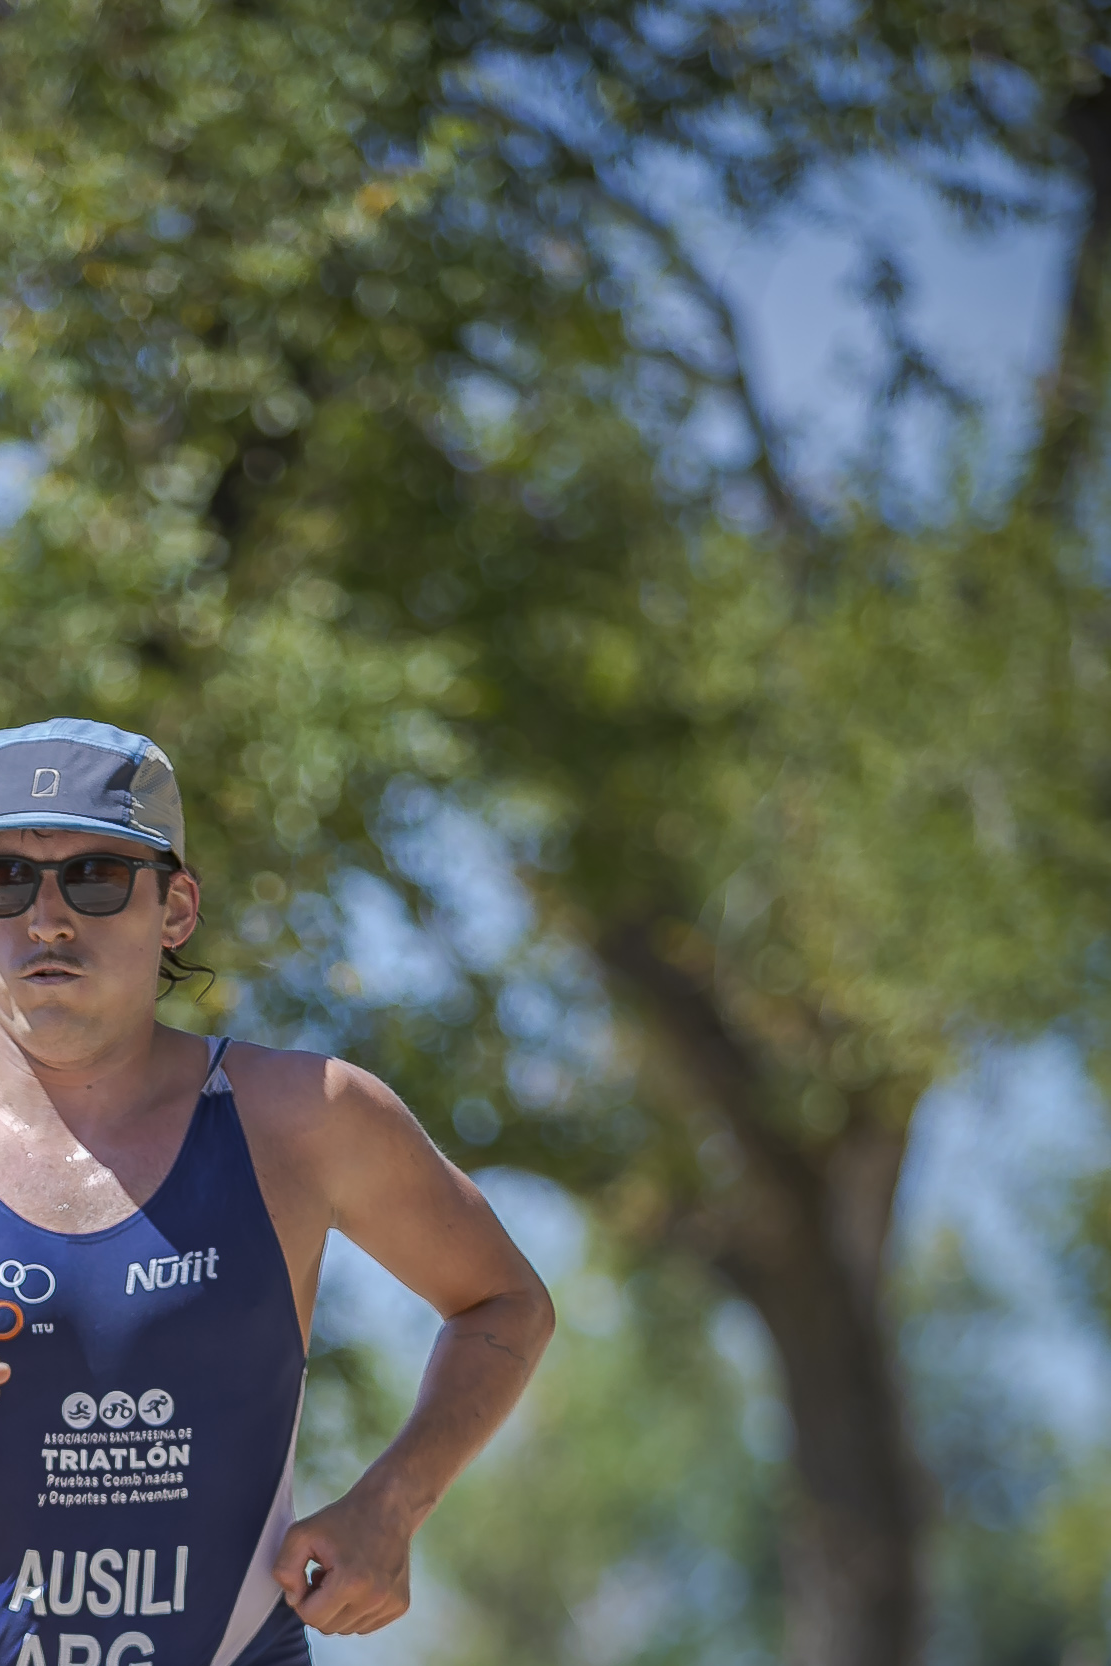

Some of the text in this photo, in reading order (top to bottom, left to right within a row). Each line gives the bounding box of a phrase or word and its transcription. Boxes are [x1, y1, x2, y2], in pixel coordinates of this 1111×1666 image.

[32, 1322, 55, 1334] ITU
[178, 1427, 193, 1440] DE
[41, 1441, 190, 1471] TRIATLÓN
[46, 1471, 184, 1488] Pruebas Combnadas
[38, 1487, 189, 1508] y Deportes de Aventura
[8, 1545, 189, 1617] AUSILI
